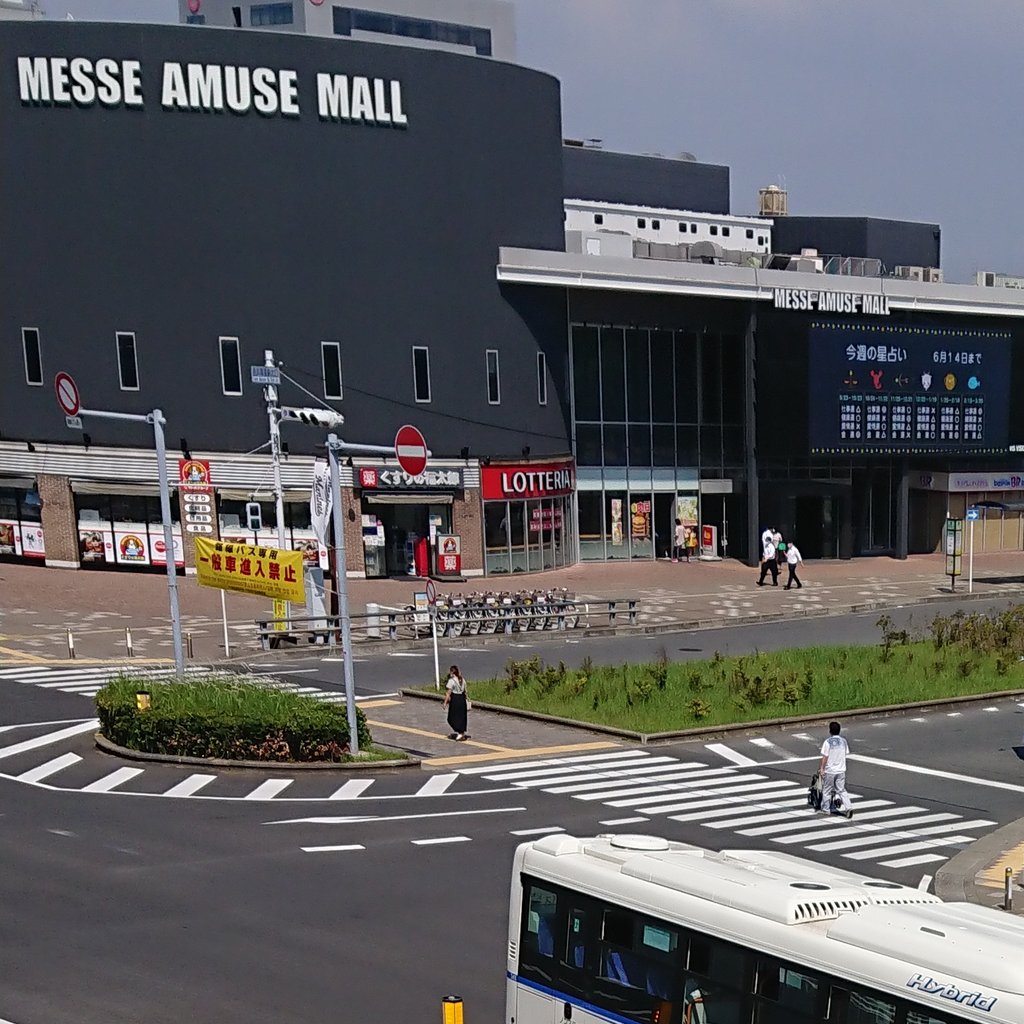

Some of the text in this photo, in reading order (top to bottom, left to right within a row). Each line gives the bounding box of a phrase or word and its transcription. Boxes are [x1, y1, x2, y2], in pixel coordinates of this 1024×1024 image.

[17, 57, 408, 123] MESSE AMUSE MALL
[774, 288, 891, 316] MESSE AMUSE MALL
[846, 344, 982, 364] 今週の星占い 6月14日まで
[502, 470, 571, 493] LOTTERIA
[200, 553, 297, 583] 一般車進入禁止
[906, 973, 997, 1012] Hybrid
